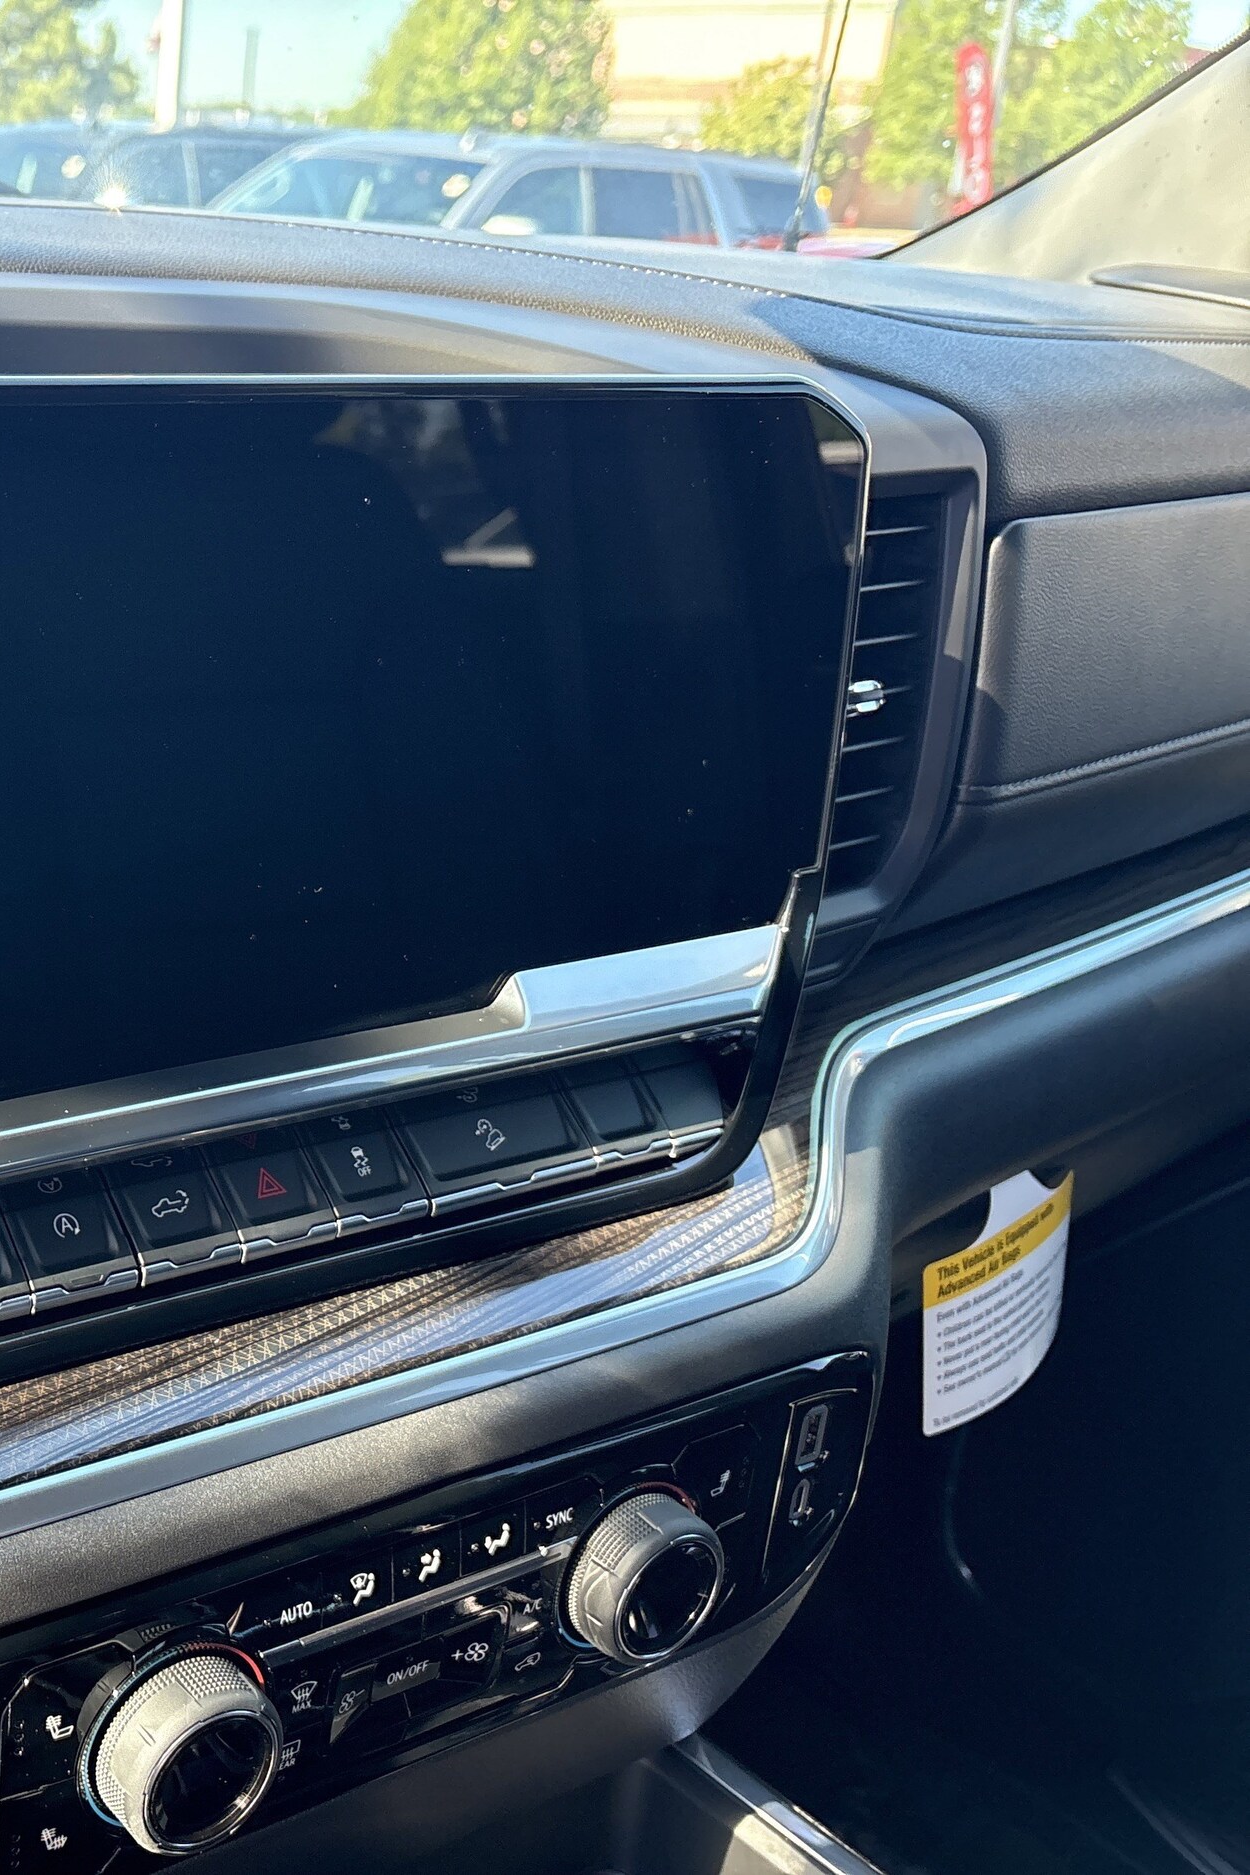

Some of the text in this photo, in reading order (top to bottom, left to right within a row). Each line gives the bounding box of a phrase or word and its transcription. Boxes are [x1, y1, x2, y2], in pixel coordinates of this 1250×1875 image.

[357, 1165, 371, 1177] OFF
[59, 1217, 74, 1234] A
[937, 1264, 960, 1281] This
[962, 1247, 995, 1271] Vehicle
[996, 1239, 1004, 1252] is
[1005, 1215, 1039, 1246] Equipped
[937, 1268, 986, 1299] Advanced
[988, 1258, 999, 1274] Air
[1001, 1244, 1021, 1265] Bags
[545, 1507, 574, 1530] SYNC
[279, 1601, 313, 1625] AUTO
[523, 1597, 543, 1615] A/C
[386, 1659, 429, 1686] ON/OFF
[291, 1700, 312, 1714] MAX
[278, 1758, 296, 1771] EAR
